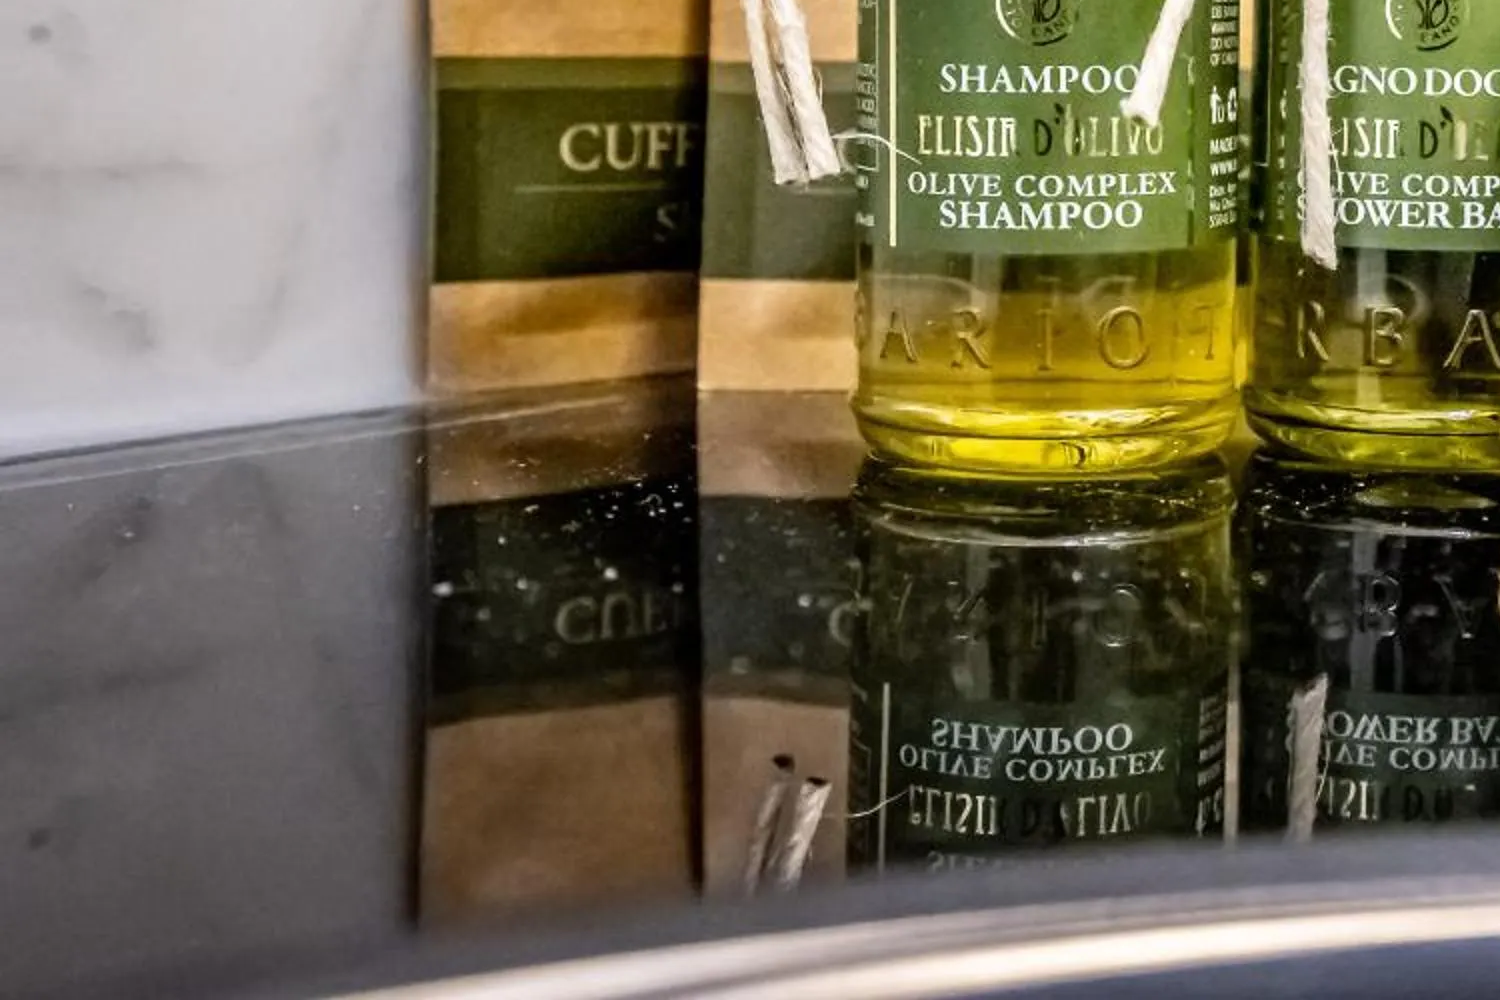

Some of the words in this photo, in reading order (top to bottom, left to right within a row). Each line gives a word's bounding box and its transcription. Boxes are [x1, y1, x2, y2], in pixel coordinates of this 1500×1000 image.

[938, 63, 1142, 95] SHAMPOO
[1316, 65, 1418, 96] GNO
[906, 170, 1003, 197] OLIVE
[1014, 171, 1178, 198] COMPLEX
[938, 199, 1144, 231] SHAMPOO
[1316, 198, 1454, 230] OWER
